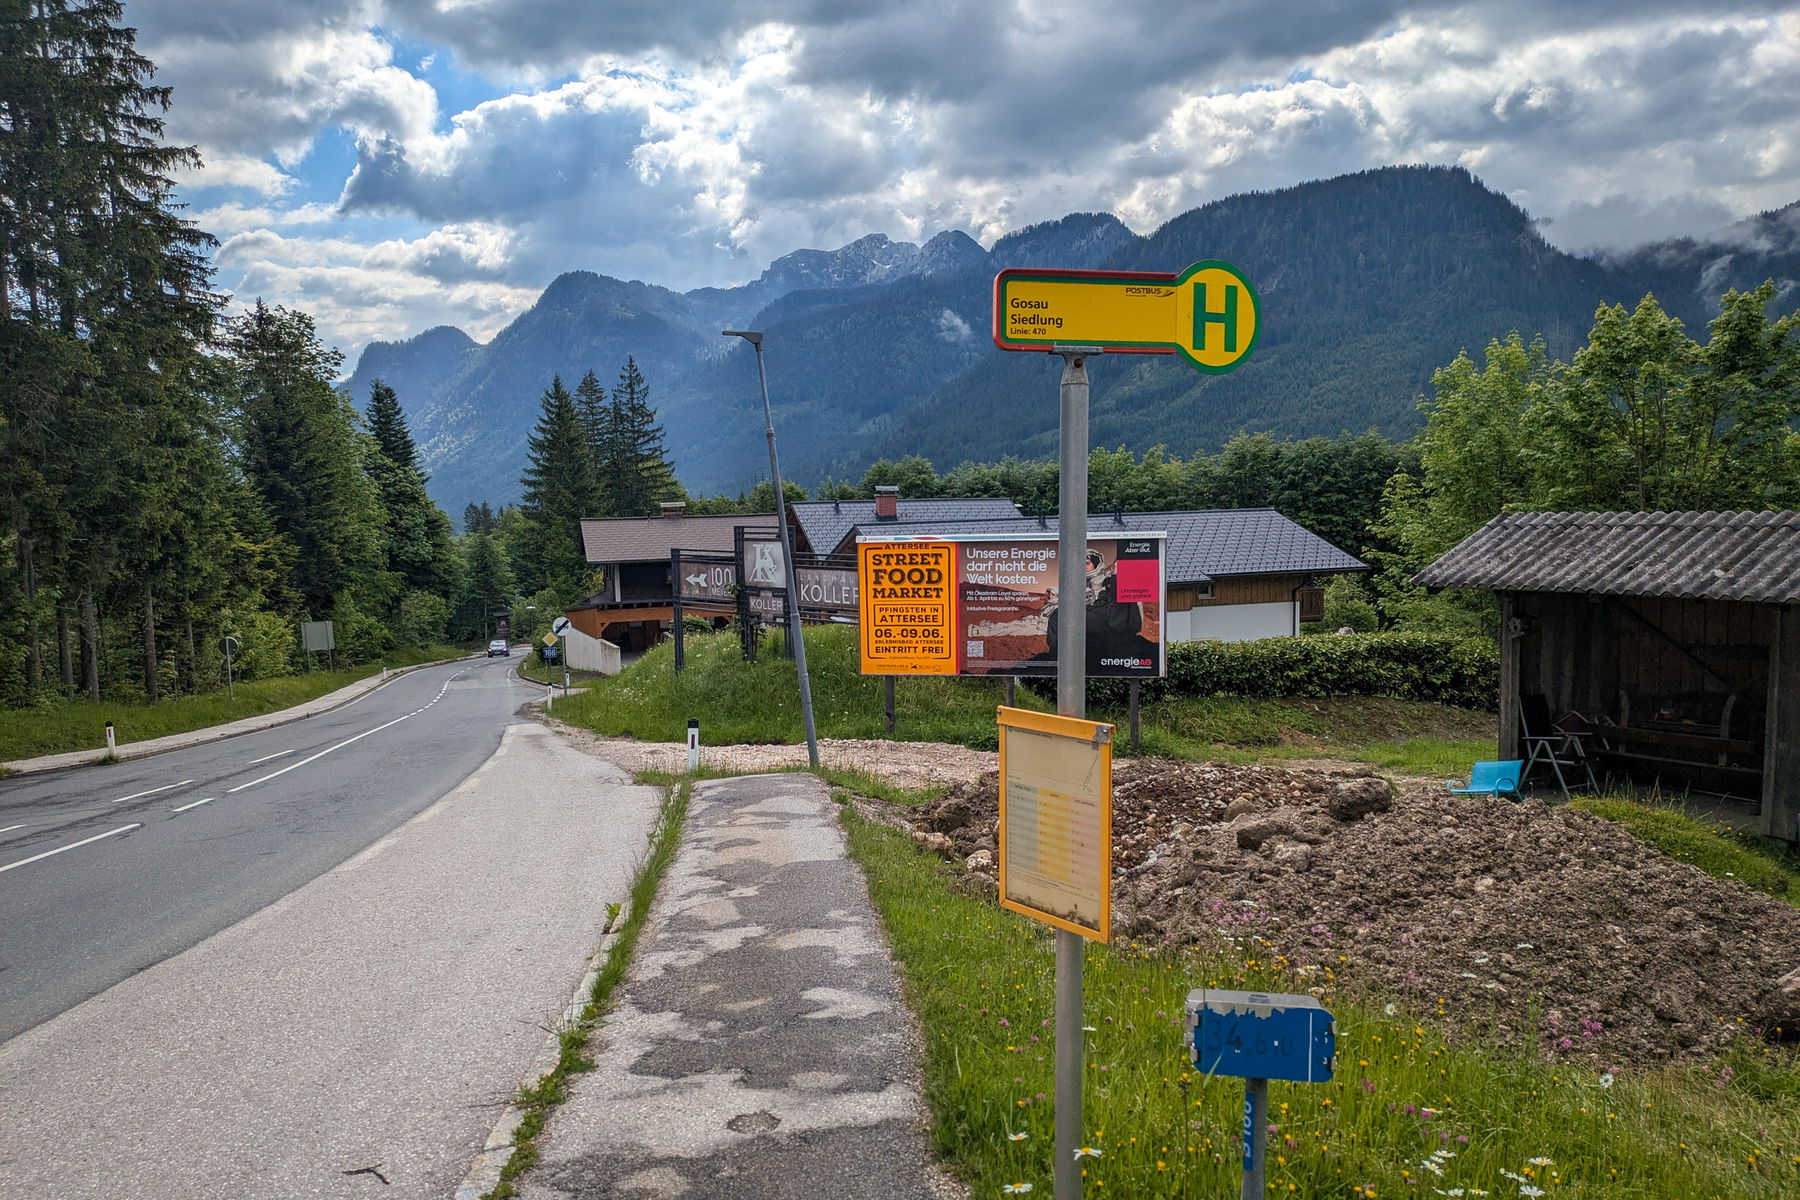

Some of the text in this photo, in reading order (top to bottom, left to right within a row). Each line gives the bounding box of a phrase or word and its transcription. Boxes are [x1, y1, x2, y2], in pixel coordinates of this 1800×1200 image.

[1126, 287, 1162, 295] POSTBUS
[1010, 297, 1048, 309] Gosau
[1010, 314, 1063, 328] Siedlung
[1192, 282, 1238, 352] H
[1010, 327, 1031, 335] Linie:
[872, 553, 943, 566] STREET
[966, 548, 1056, 560] Unsere Energie
[966, 561, 1047, 571] darf nicht die
[711, 567, 732, 586] 100
[873, 568, 943, 585] FOOD
[966, 573, 1039, 584] Welt kosten.
[872, 587, 943, 599] MARKET
[750, 598, 783, 611] KOLLER
[880, 614, 939, 623] ATTERSEE
[874, 628, 944, 639] 06.-09.06.
[875, 646, 944, 654] EINTRITT FREI
